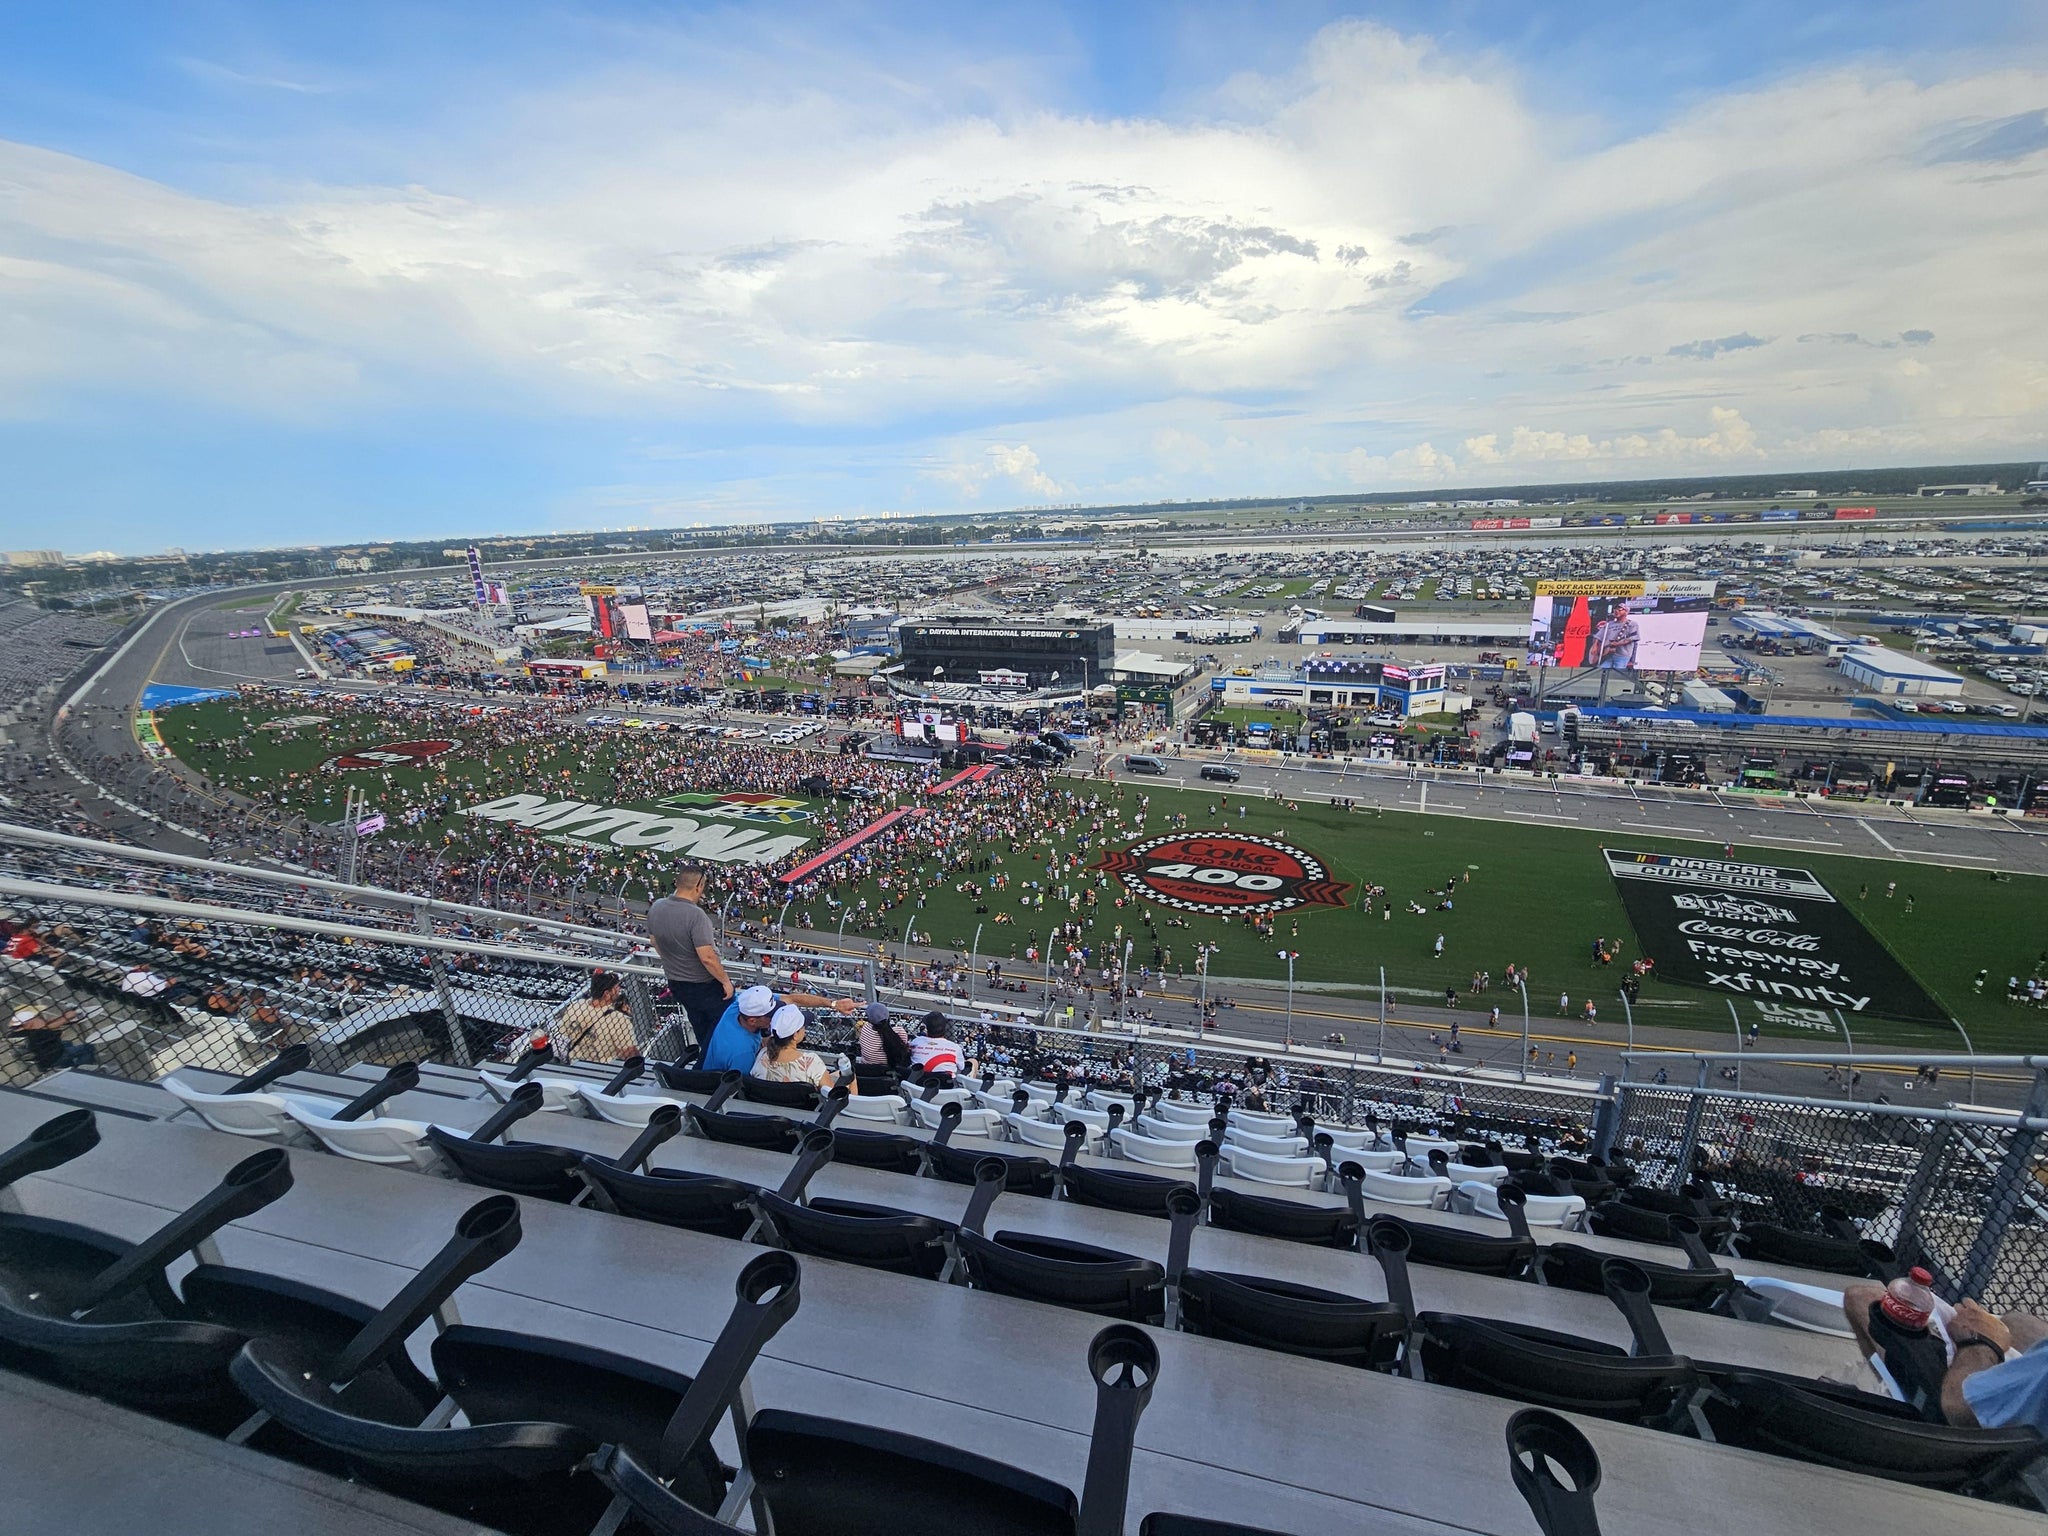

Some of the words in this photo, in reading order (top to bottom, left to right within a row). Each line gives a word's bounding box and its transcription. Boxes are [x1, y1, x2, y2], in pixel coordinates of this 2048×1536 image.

[1806, 511, 1828, 519] TOYOTA
[929, 628, 960, 636] DAYTONA
[961, 629, 1019, 637] INTERNATIONAL
[1021, 630, 1062, 638] SPEEDWAY
[453, 793, 810, 867] DAYTONA
[1171, 854, 1214, 865] ZERO
[1218, 861, 1274, 873] SUGAR
[1181, 841, 1280, 866] Coke
[1147, 863, 1283, 891] 400
[1640, 866, 1692, 879] CUP
[1694, 872, 1792, 891] SERIES
[1669, 858, 1778, 877] NASCAR
[1176, 885, 1249, 901] DAYTONA
[1672, 895, 1800, 924] BUSCH
[1704, 910, 1771, 924] LIGHT
[1678, 920, 1821, 951] Coca-Cola
[1687, 939, 1841, 975] Freeway
[1693, 954, 1851, 983] INSURANCE
[1704, 970, 1871, 1012] xfinity
[1762, 1013, 1837, 1033] SPORTS
